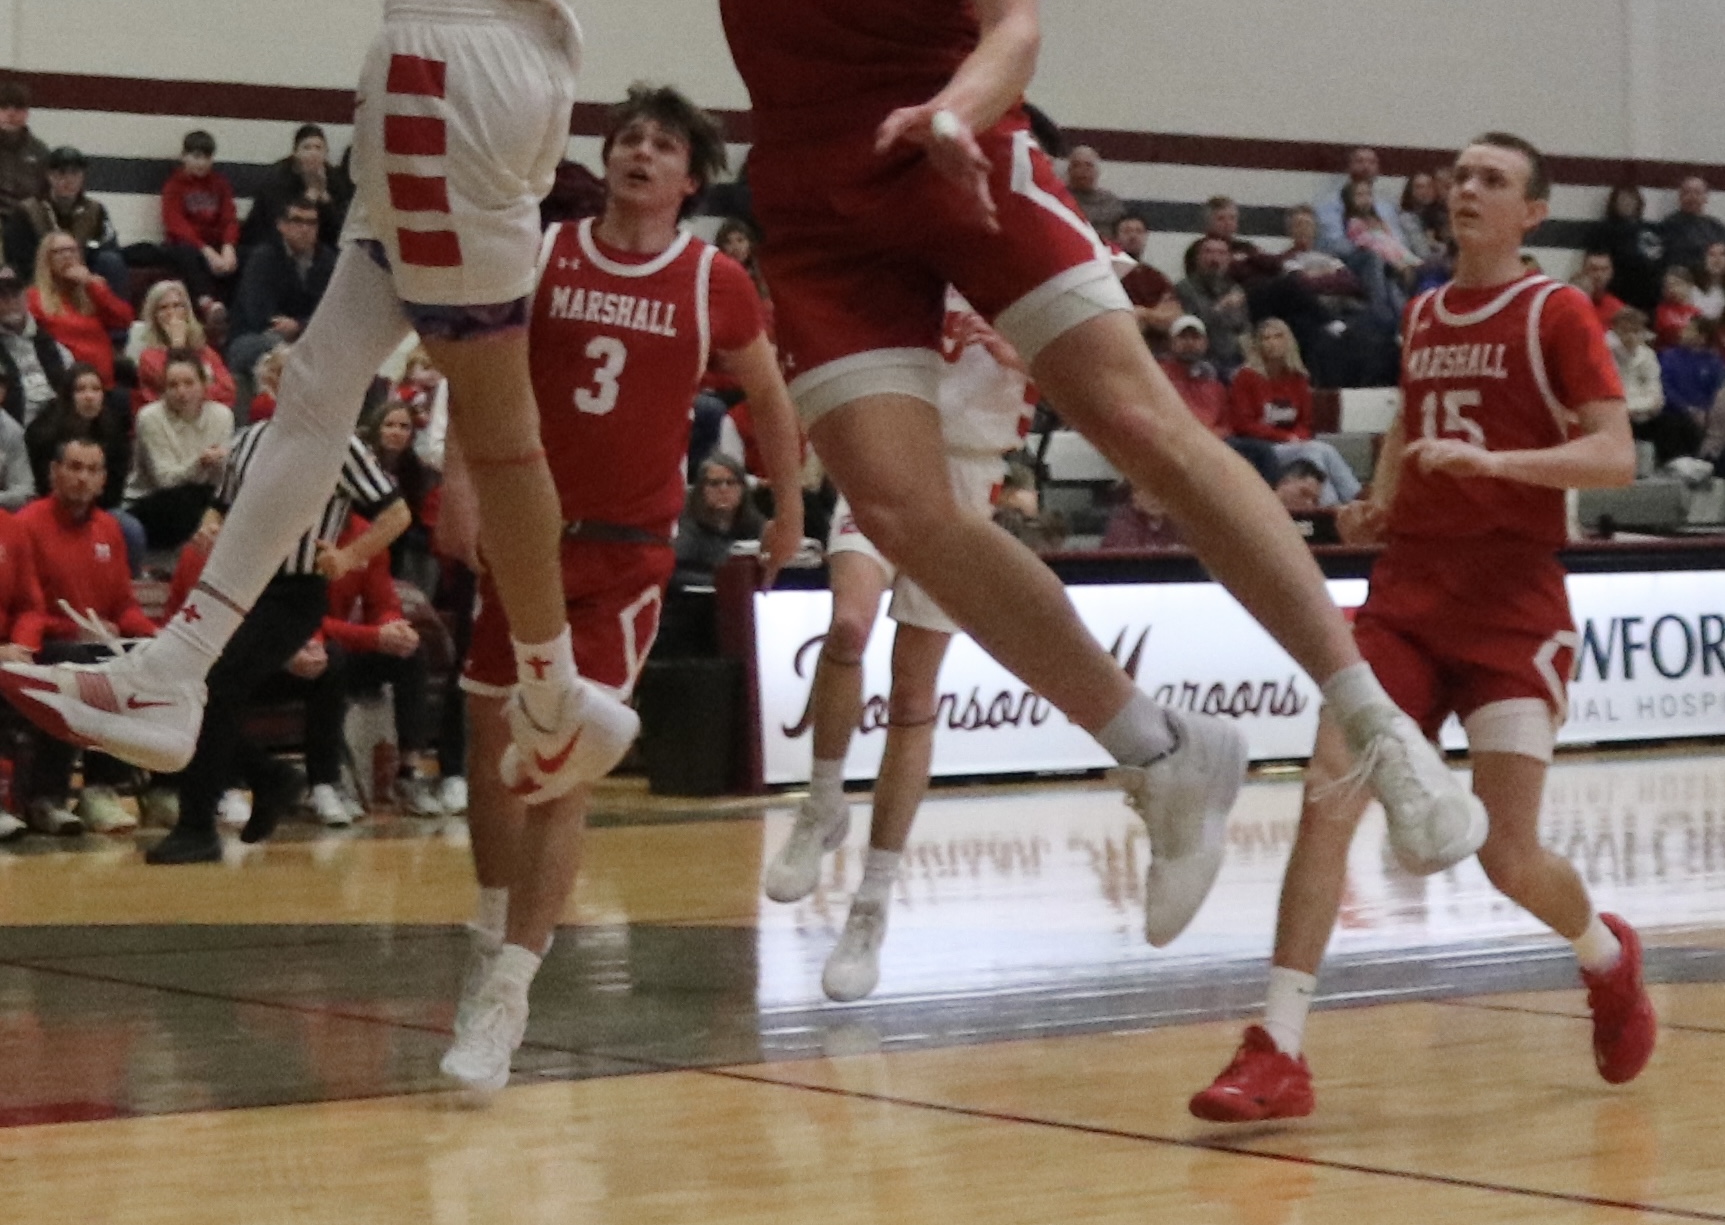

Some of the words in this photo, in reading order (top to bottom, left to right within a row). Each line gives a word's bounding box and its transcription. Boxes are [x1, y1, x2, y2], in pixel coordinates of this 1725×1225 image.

[550, 284, 678, 338] MARSHALL
[573, 334, 628, 417] 3
[1420, 389, 1487, 450] 15
